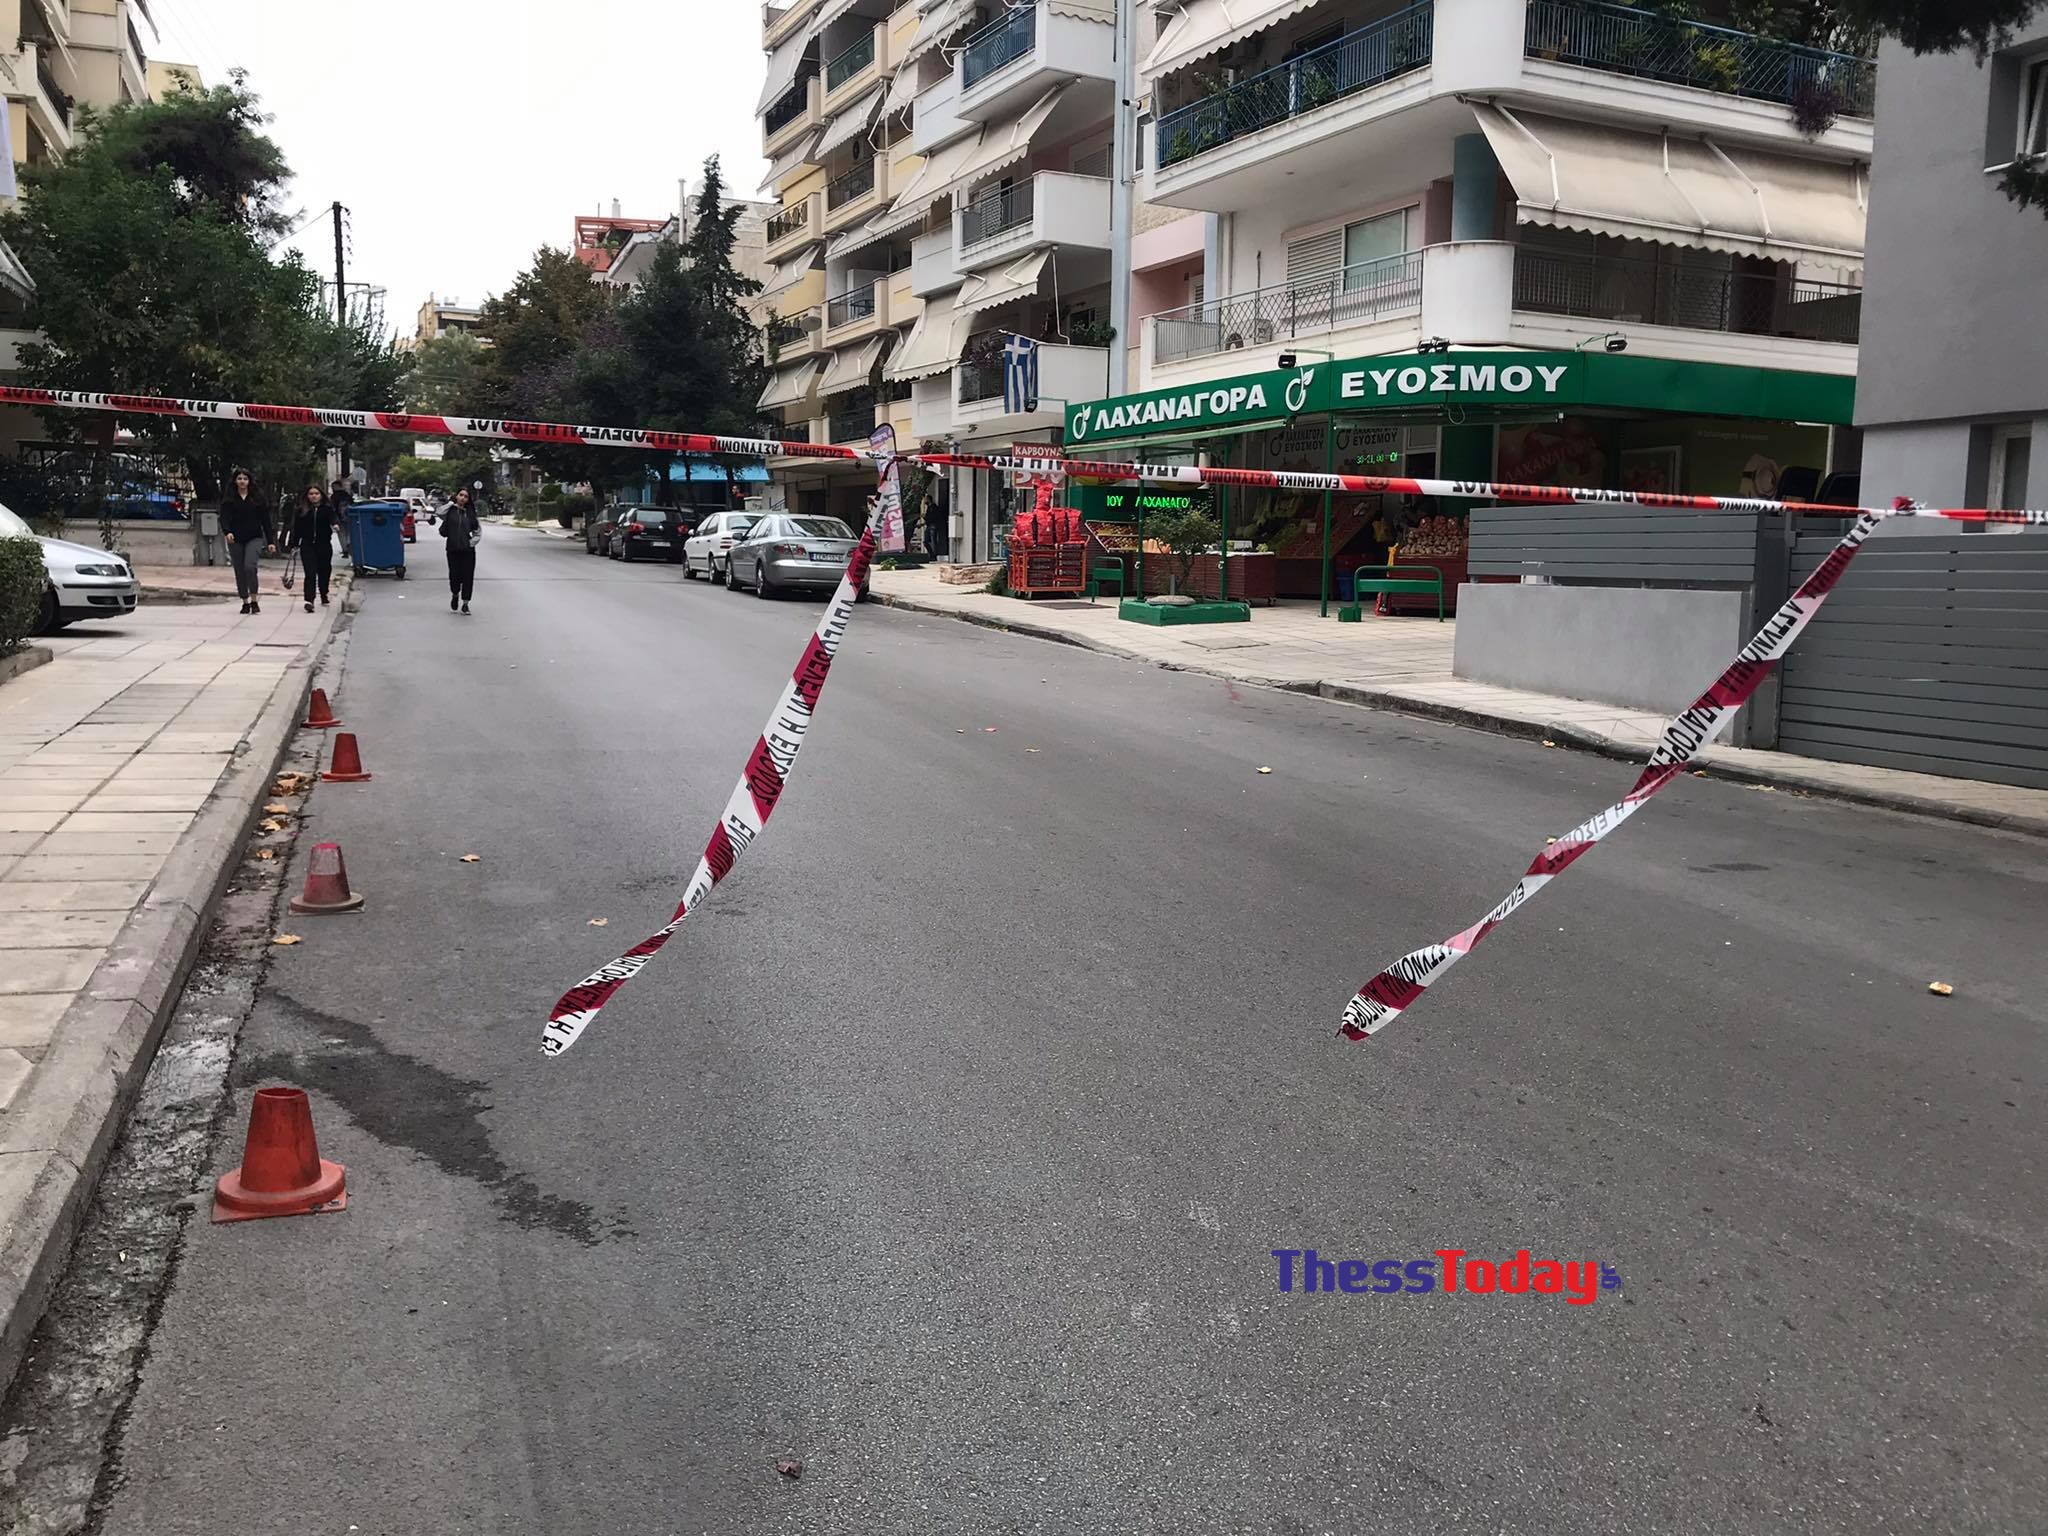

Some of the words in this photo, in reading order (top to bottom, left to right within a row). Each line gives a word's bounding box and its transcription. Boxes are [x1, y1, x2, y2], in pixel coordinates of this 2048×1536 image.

[1094, 384, 1267, 431] ΛΑΧΑΝΑΓΟΡΑ
[1341, 365, 1568, 399] ΕΥΟΣΜΟΥ
[709, 437, 780, 455] ΑΣΤΥΝΟΜΙΑ
[1353, 431, 1398, 446] ΕΥΟΣΜΟΥ
[1276, 474, 1340, 490] ΕΛΛΗΝΙΚΗ
